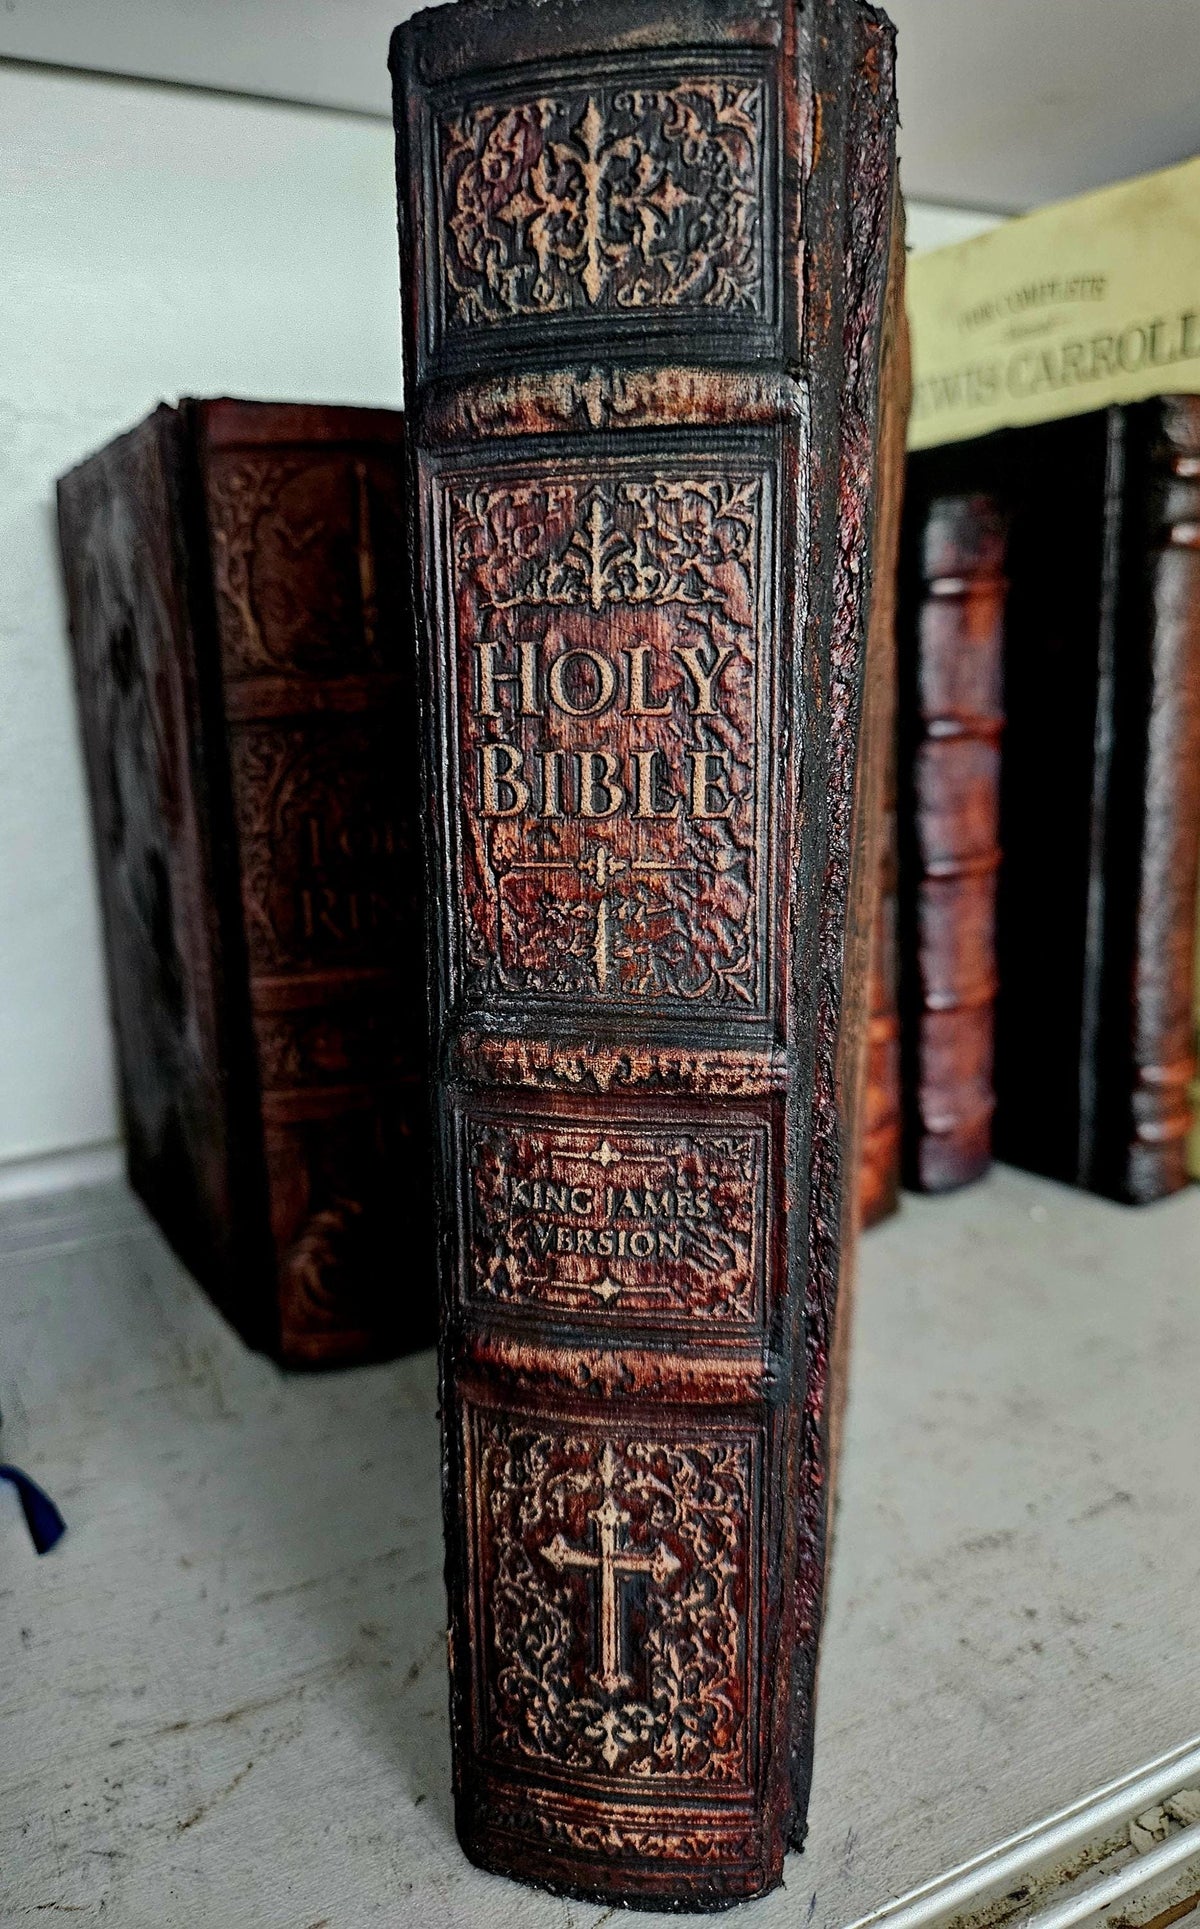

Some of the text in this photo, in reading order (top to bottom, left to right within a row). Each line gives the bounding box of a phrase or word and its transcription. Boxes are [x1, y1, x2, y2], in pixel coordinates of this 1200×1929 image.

[1004, 309, 1200, 400] CARROLL
[473, 640, 735, 718] HOLY
[475, 743, 736, 820] BIBLE
[510, 1176, 711, 1219] KING JAMES
[532, 1219, 686, 1258] VERSION
